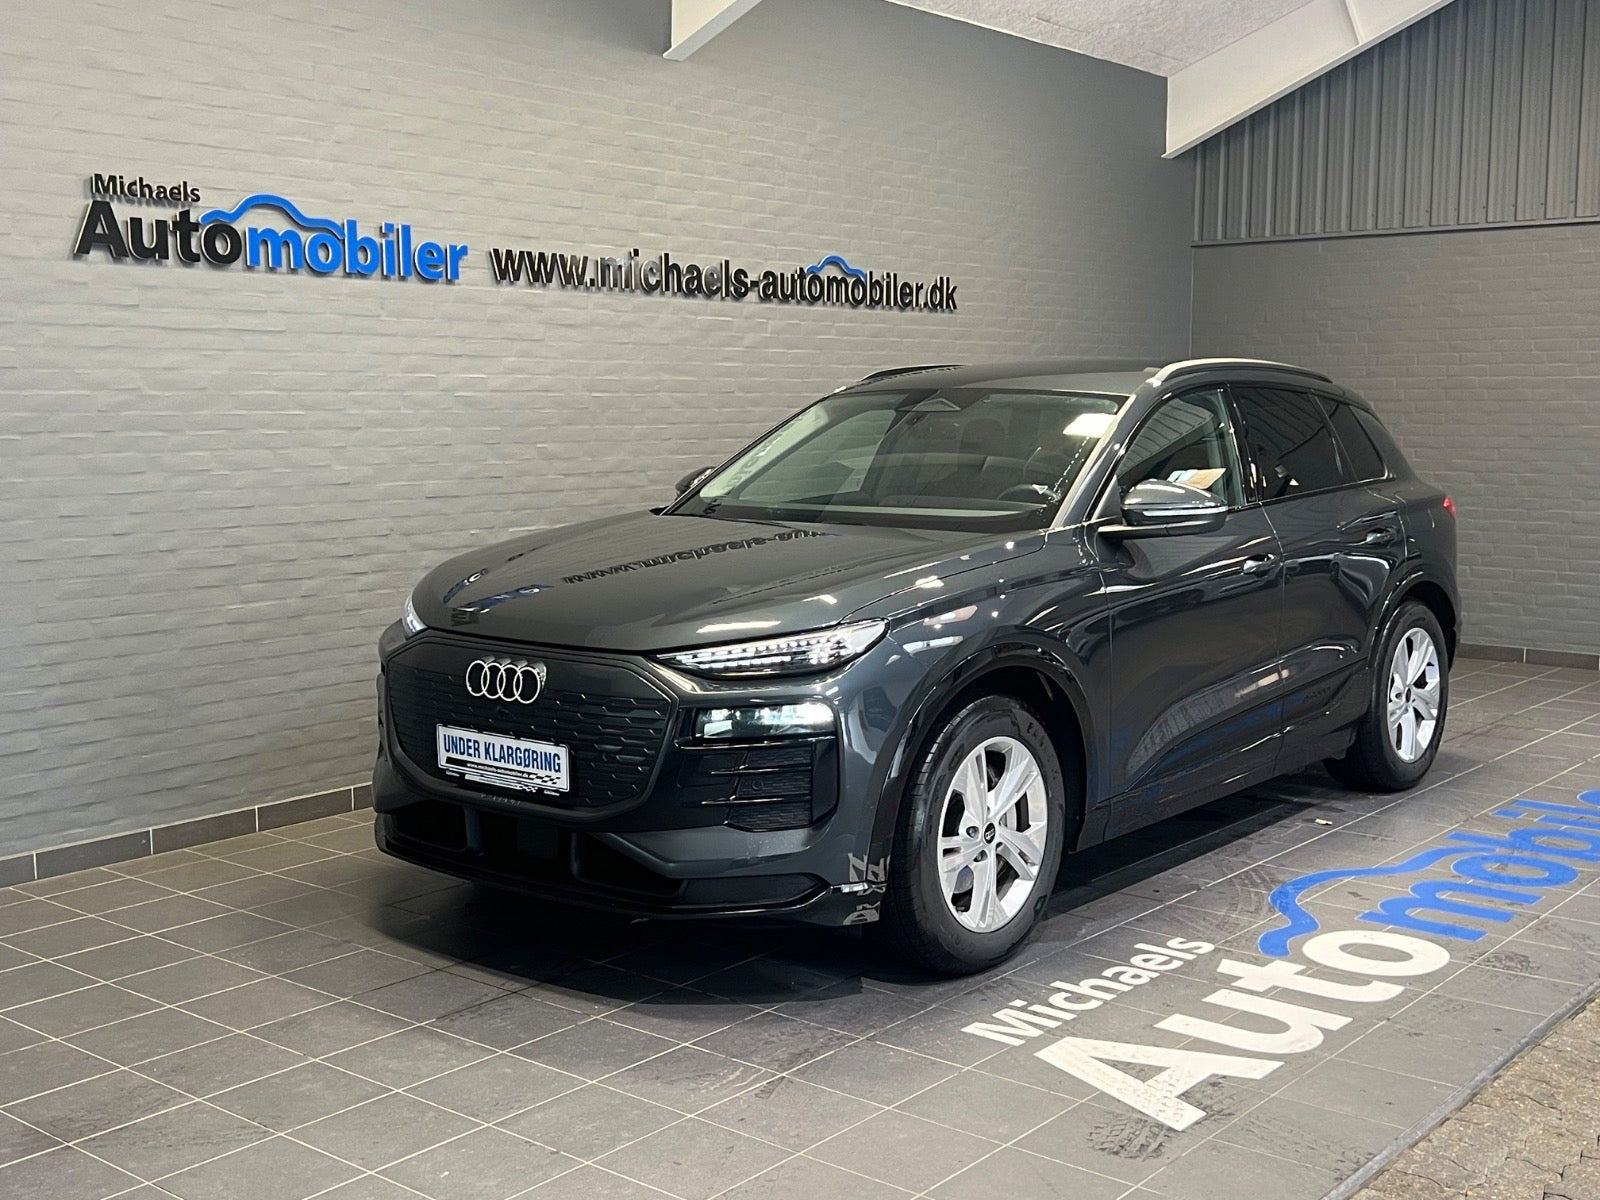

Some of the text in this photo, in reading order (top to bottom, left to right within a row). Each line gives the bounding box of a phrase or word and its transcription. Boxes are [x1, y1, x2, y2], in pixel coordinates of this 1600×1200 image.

[91, 173, 200, 202] Michaels
[74, 199, 467, 281] Automobiler
[490, 247, 957, 312] www.michaels-automobiler.dk
[443, 734, 481, 759] UNDER
[484, 741, 561, 774] KLARGØRING
[960, 937, 1215, 1047] Michaels
[1033, 789, 1600, 1132] Automobil
